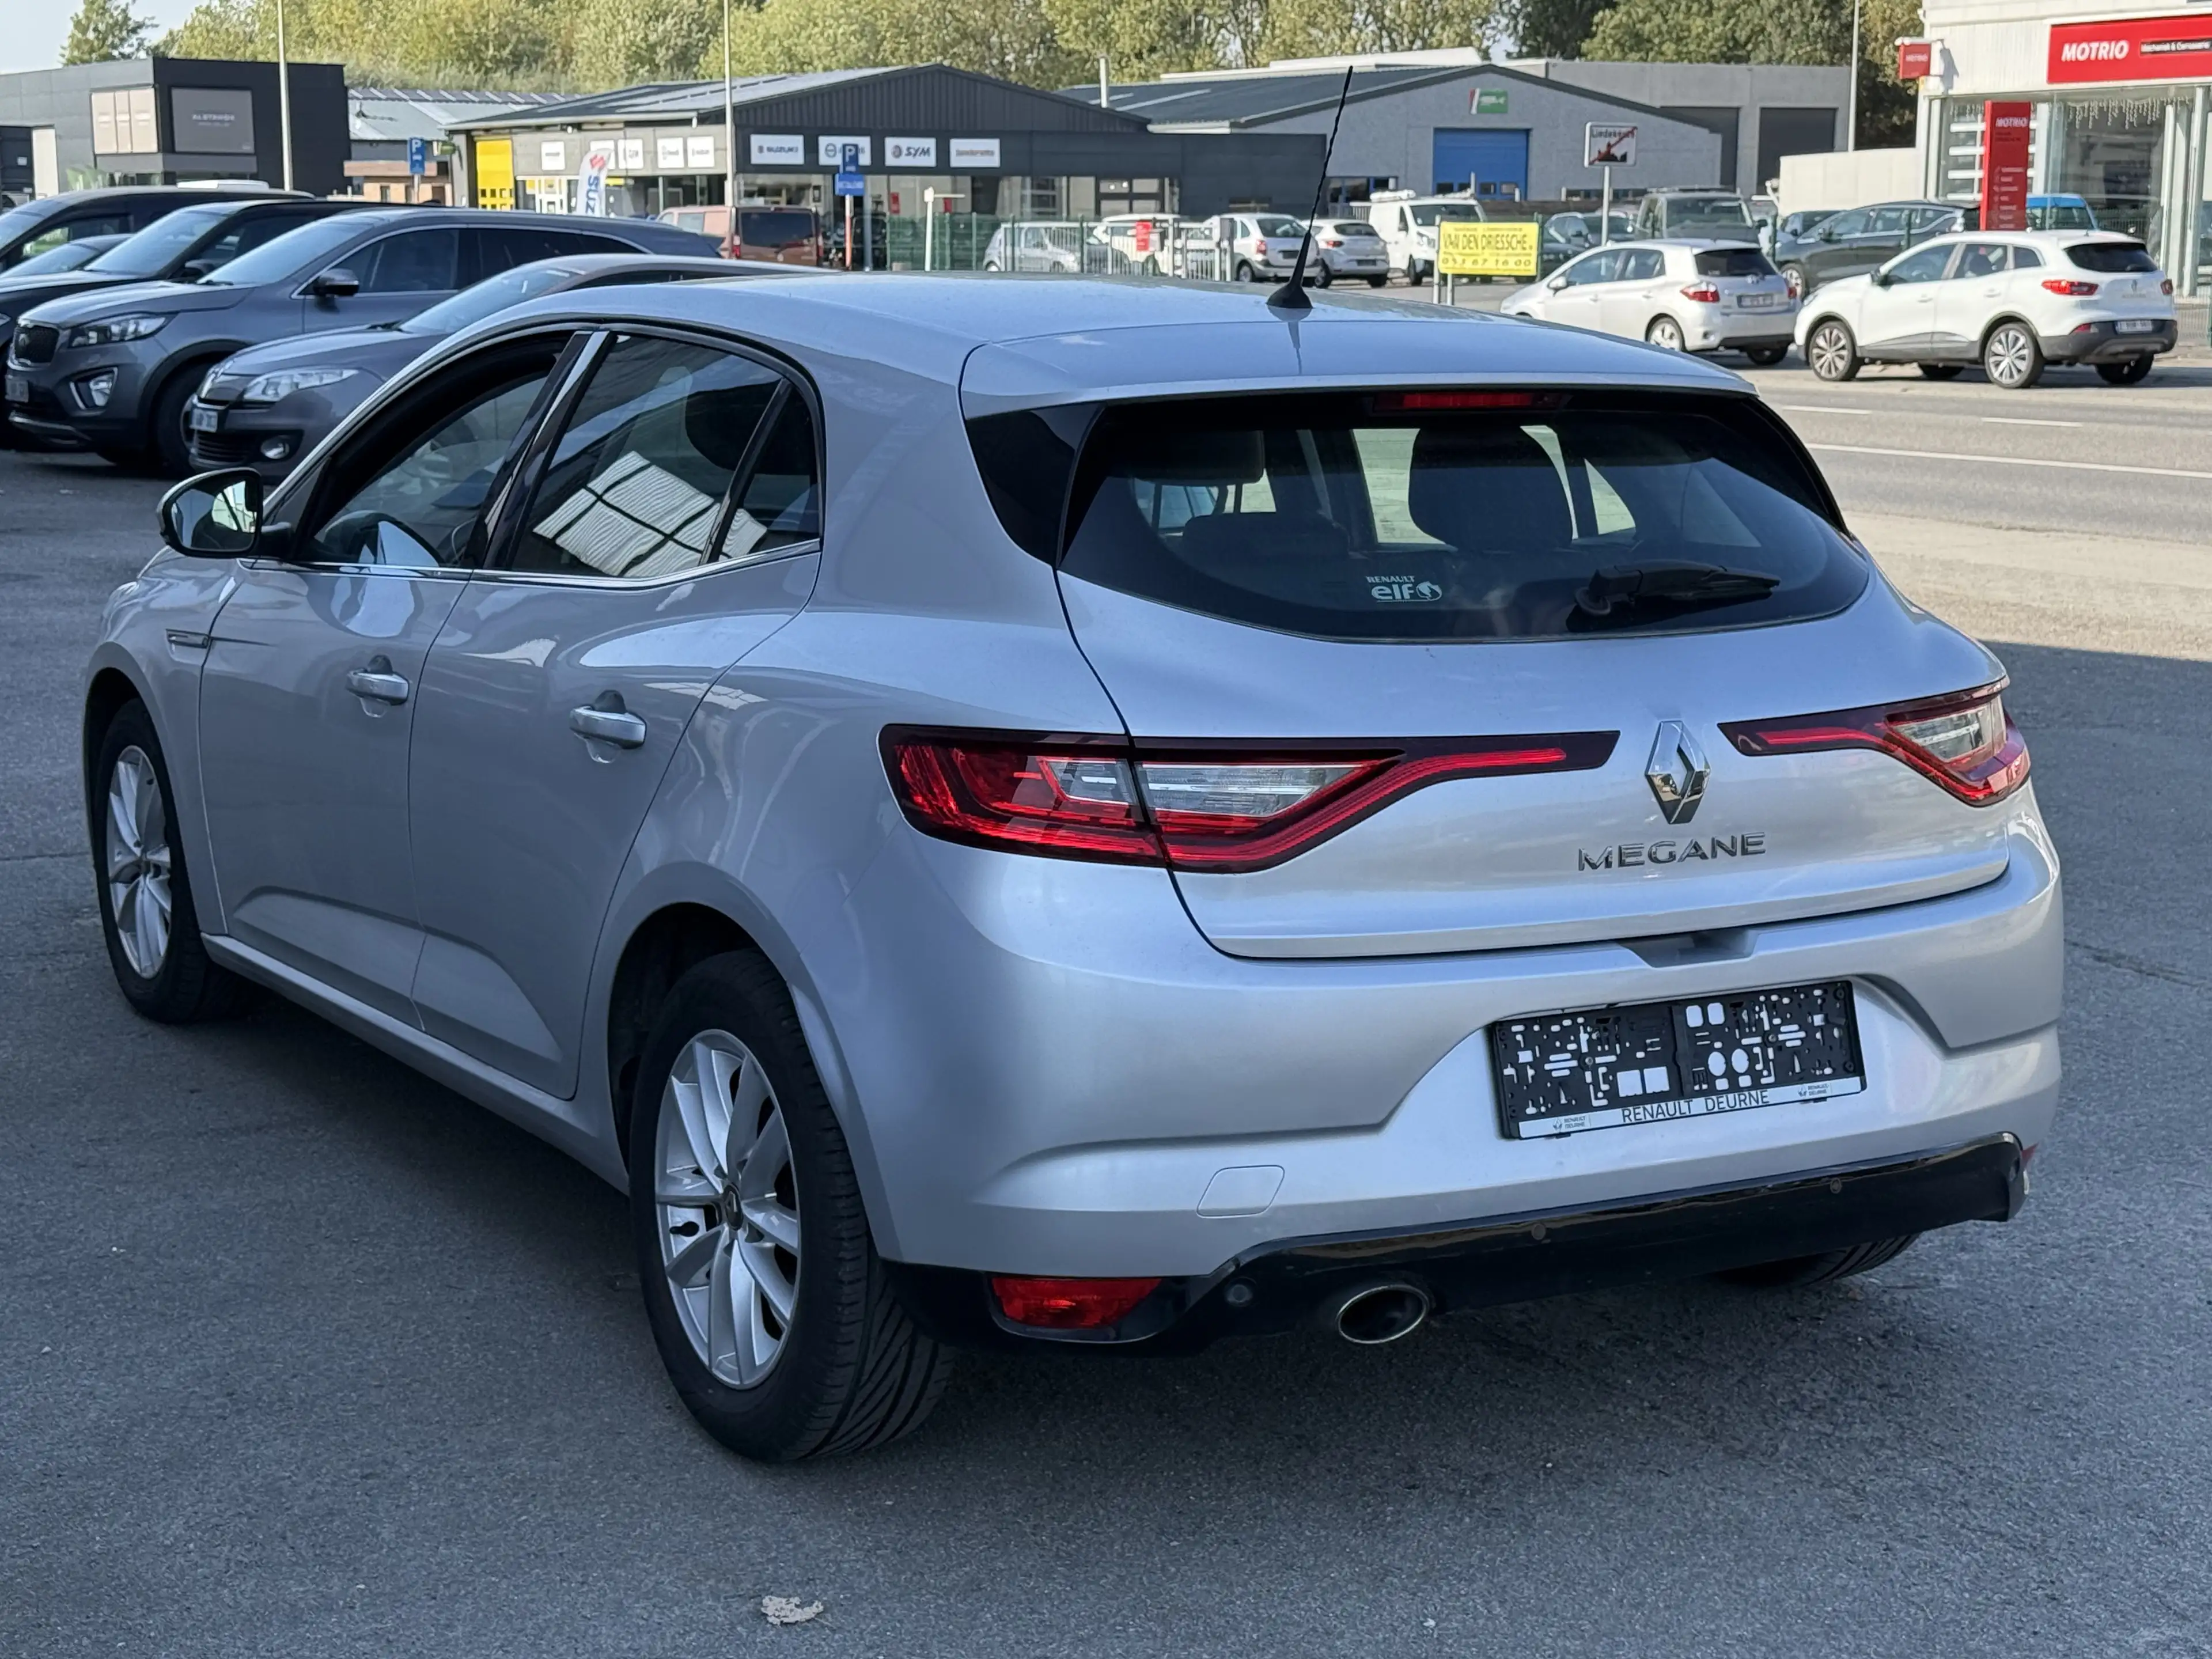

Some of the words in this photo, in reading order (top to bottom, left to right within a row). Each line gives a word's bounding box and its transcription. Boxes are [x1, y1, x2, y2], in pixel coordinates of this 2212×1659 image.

[2061, 40, 2130, 62] MOTRIO
[1995, 117, 2028, 127] MOTRIO
[412, 139, 422, 153] P
[845, 145, 855, 162] P
[905, 146, 930, 158] SYM
[1462, 233, 1479, 250] DEN
[1372, 584, 1414, 600] elf
[1578, 831, 1766, 872] MEGANE
[1622, 1099, 1694, 1123] RENAULT
[1705, 1089, 1770, 1112] DEURNE
